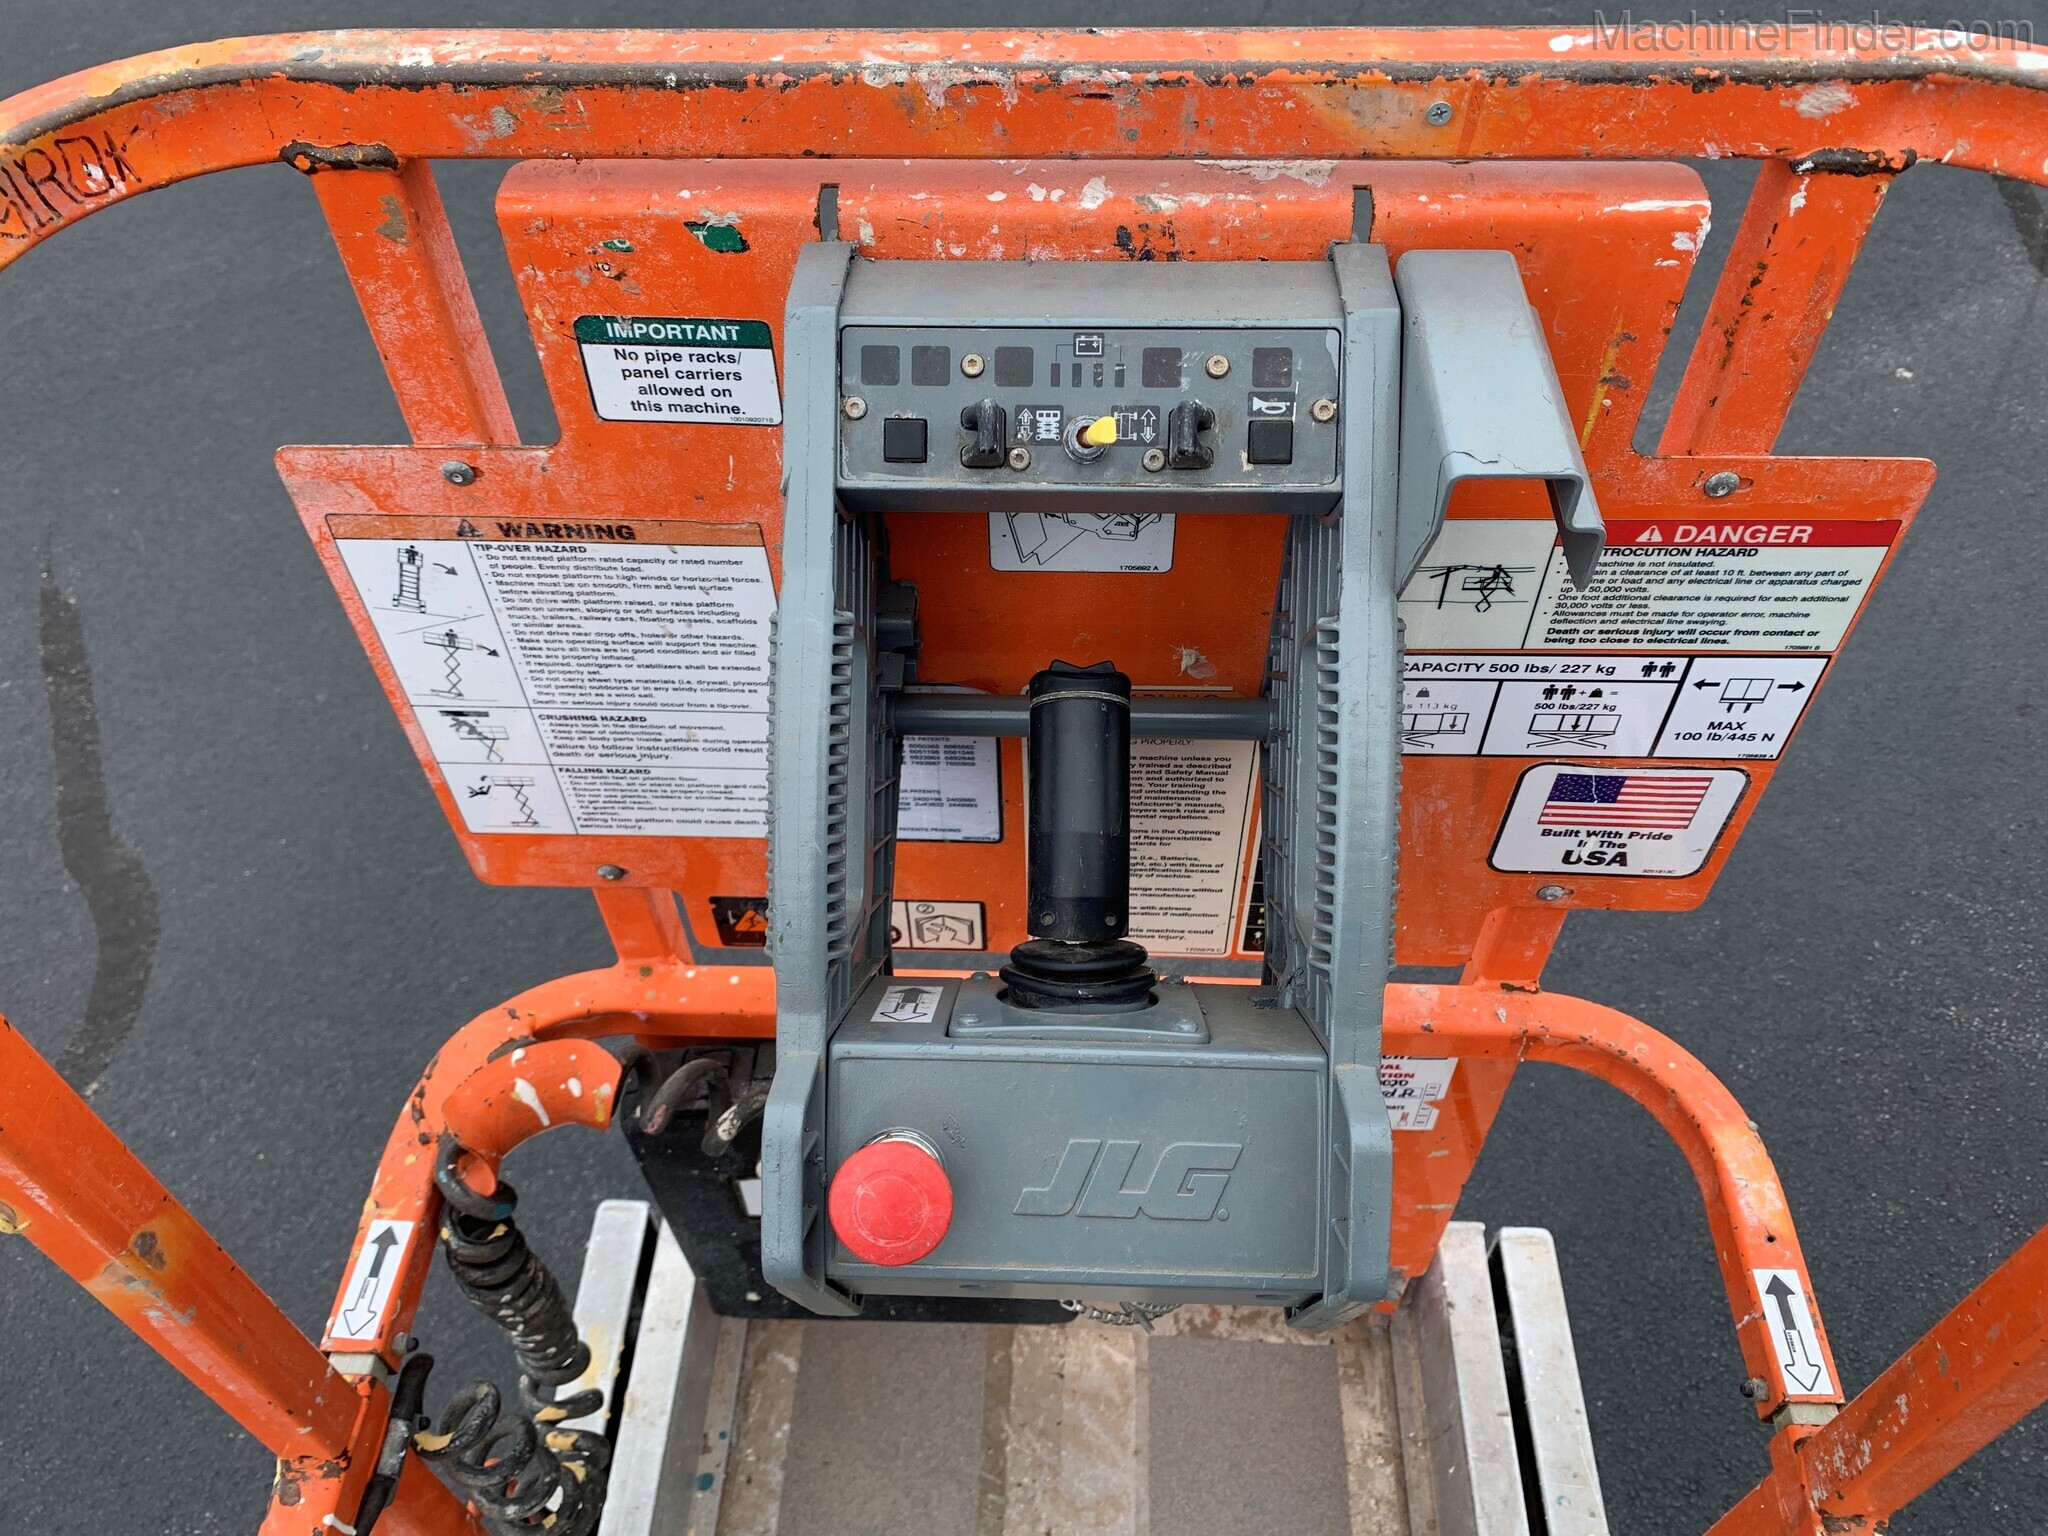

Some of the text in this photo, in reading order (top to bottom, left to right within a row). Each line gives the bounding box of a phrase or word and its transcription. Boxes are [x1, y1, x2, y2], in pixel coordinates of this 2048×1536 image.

[605, 322, 739, 340] IMPORTANT
[613, 348, 741, 364] No pipe racks/
[621, 367, 742, 381] panel carriers
[638, 383, 732, 397] allowed on
[630, 400, 745, 414] this machine.
[498, 521, 638, 542] WARNING
[1673, 525, 1813, 543] DANGER
[535, 545, 586, 553] HAZARD
[1602, 547, 1759, 557] TROCUTION HAZARD
[538, 563, 569, 571] Evenly
[1820, 578, 1862, 586] charged
[1642, 628, 1674, 636] injury
[1543, 636, 1575, 644] being
[1403, 662, 1616, 676] CAPACITY 500 lbs/ 227 kg
[1443, 703, 1457, 711] kg
[1602, 703, 1616, 711] kg
[1707, 721, 1746, 730] MAX
[1674, 732, 1775, 741] 100 lb/445 N
[1540, 828, 1672, 840] Built With Pride
[1599, 840, 1627, 848] The
[1561, 849, 1627, 866] USA
